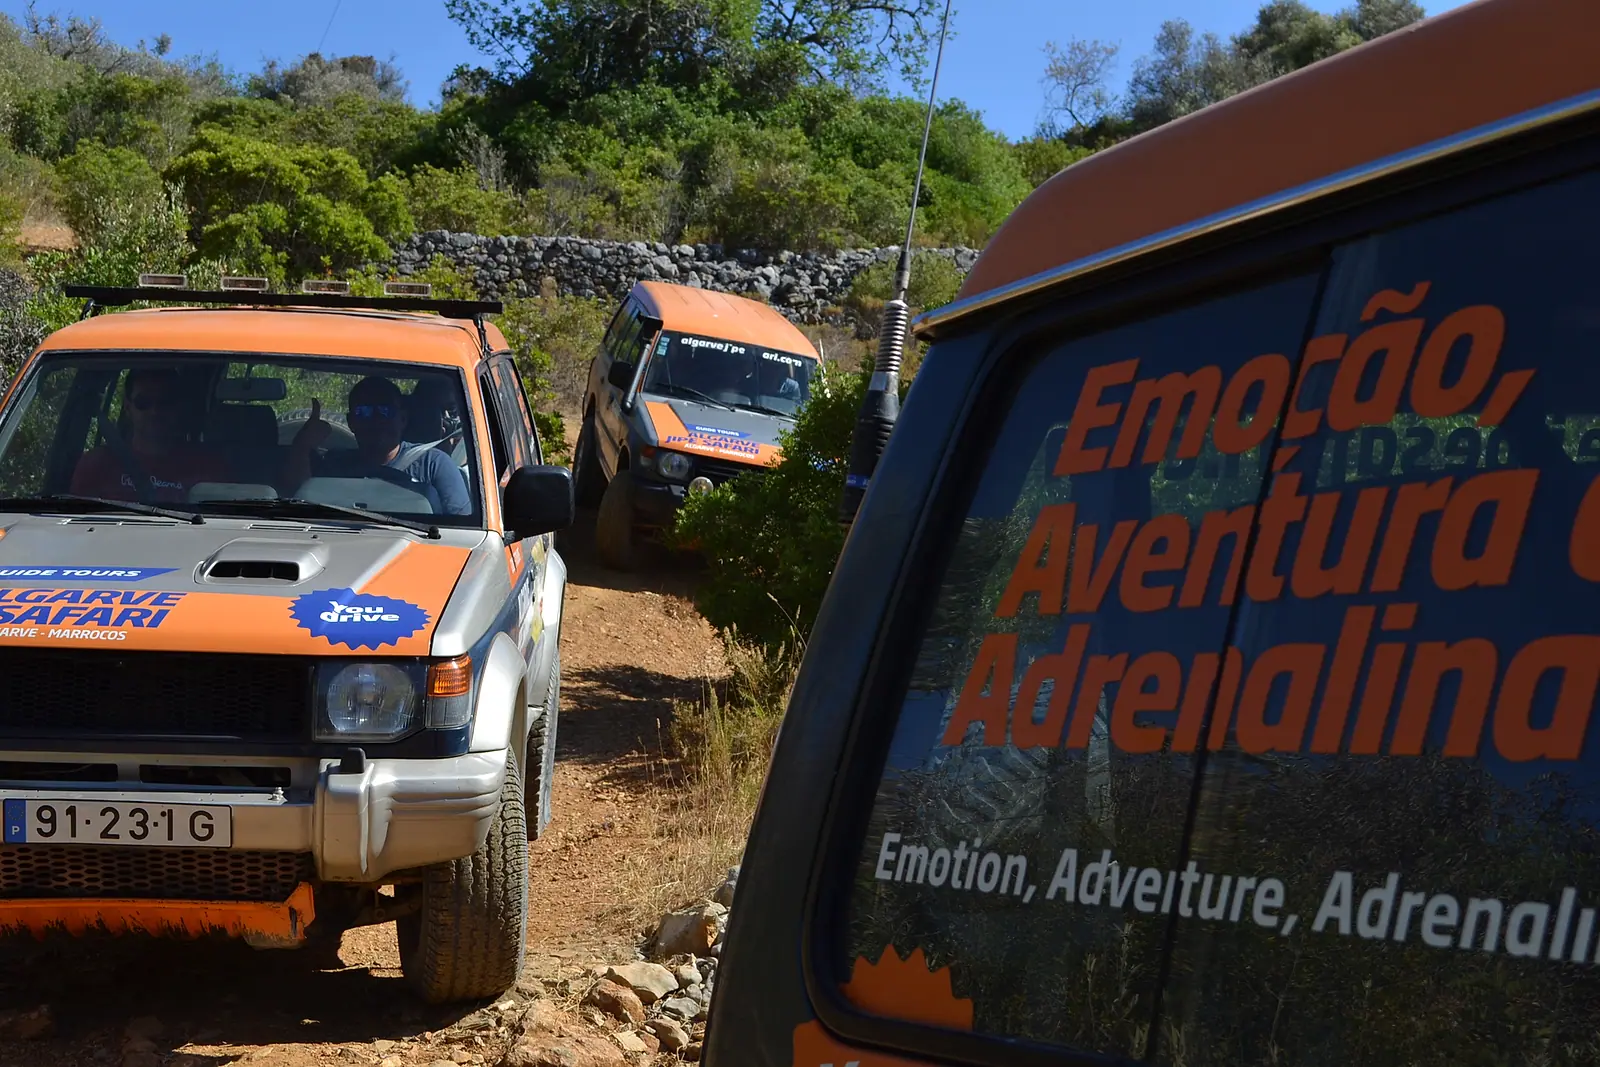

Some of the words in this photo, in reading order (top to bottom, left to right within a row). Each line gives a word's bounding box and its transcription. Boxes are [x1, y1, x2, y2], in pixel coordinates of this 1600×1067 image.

[1053, 281, 1538, 476] Emoção,
[665, 435, 697, 444] JIPE
[703, 440, 760, 454] SAFARI
[688, 432, 759, 448] ALGARVE
[994, 468, 1540, 617] Aventura
[62, 569, 142, 577] TOURS
[329, 601, 384, 614] You
[0, 605, 170, 629] SAFARI
[320, 611, 400, 622] drive
[47, 629, 128, 641] MARROCOS
[940, 603, 1600, 761] Adrenalina
[12, 826, 20, 835] P
[874, 832, 1037, 903] Emotion,
